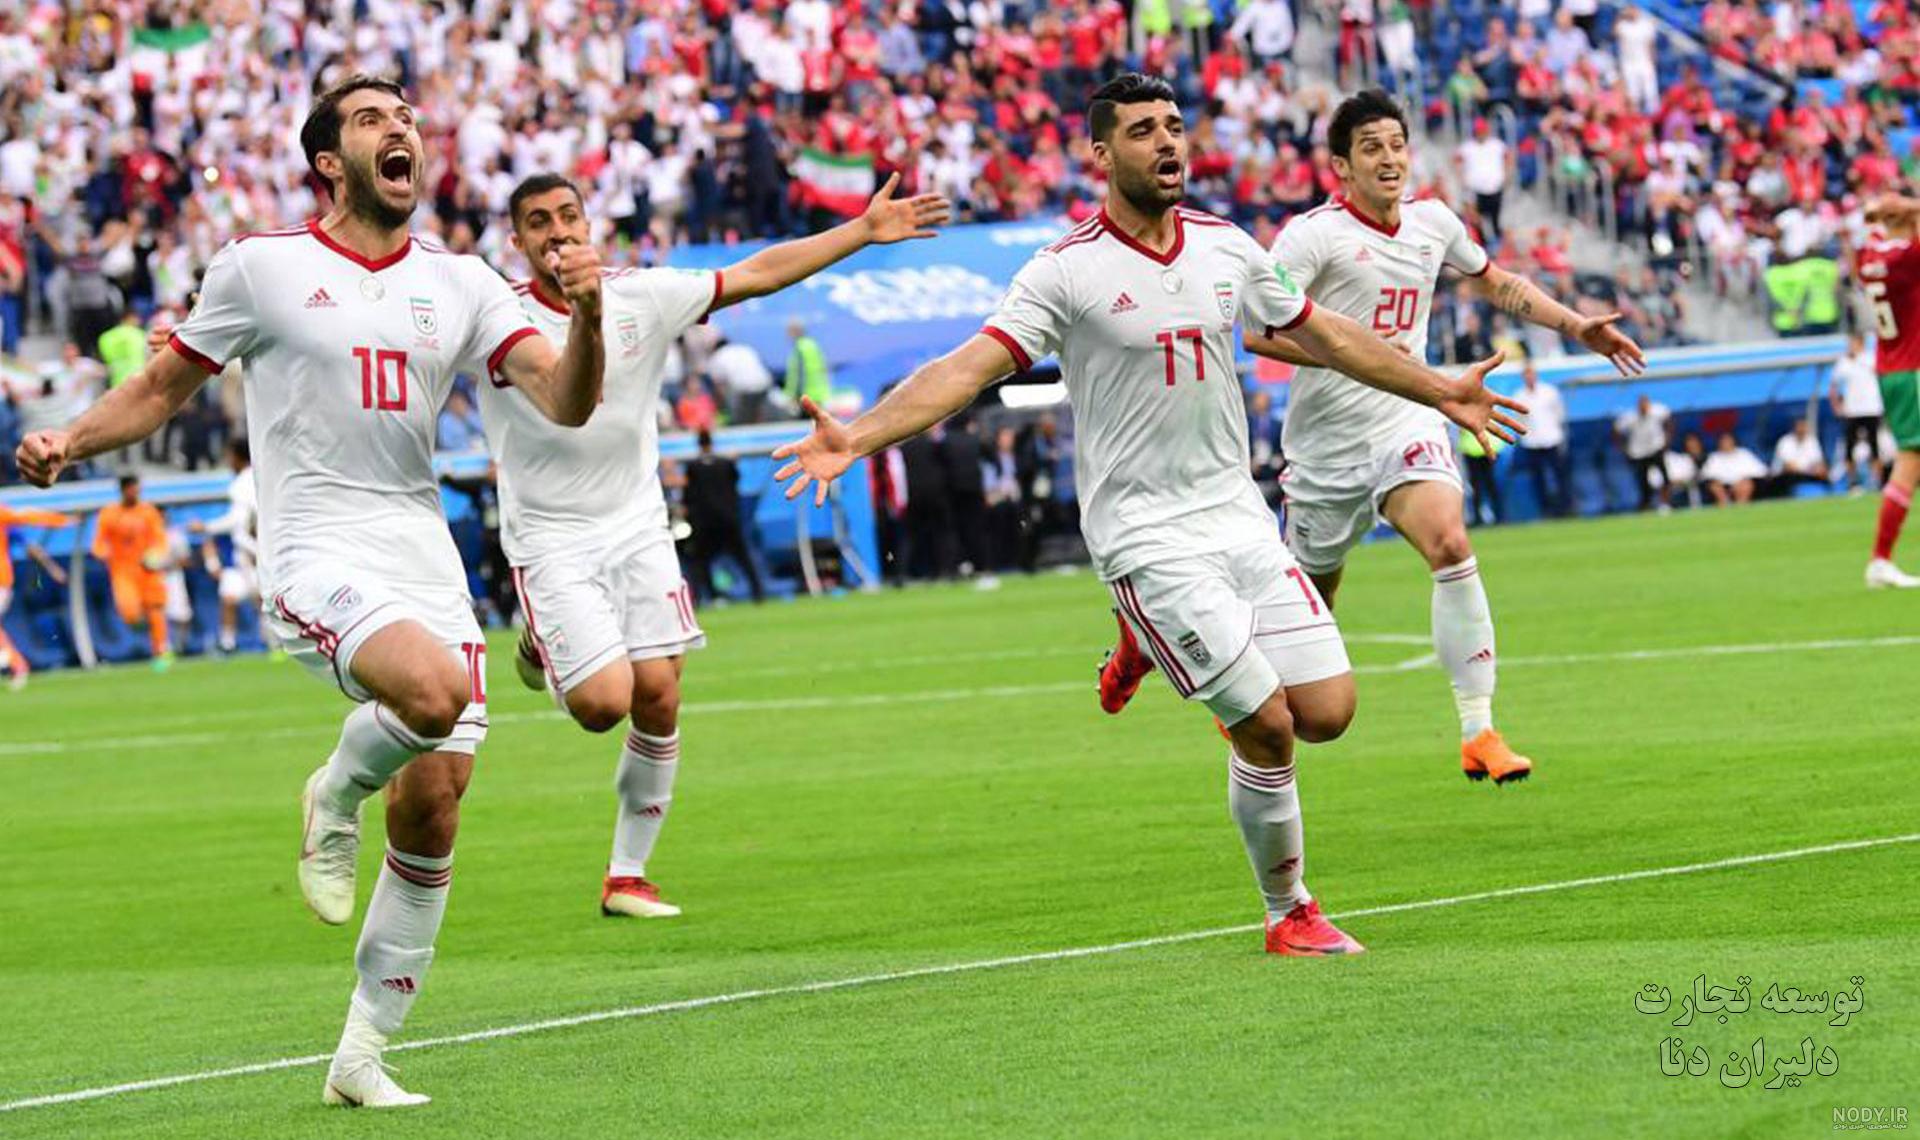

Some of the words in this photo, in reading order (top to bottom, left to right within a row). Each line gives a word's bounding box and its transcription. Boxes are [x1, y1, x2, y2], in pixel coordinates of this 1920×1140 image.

[1373, 288, 1418, 330] 20
[352, 347, 407, 411] 10
[1156, 328, 1204, 386] 17
